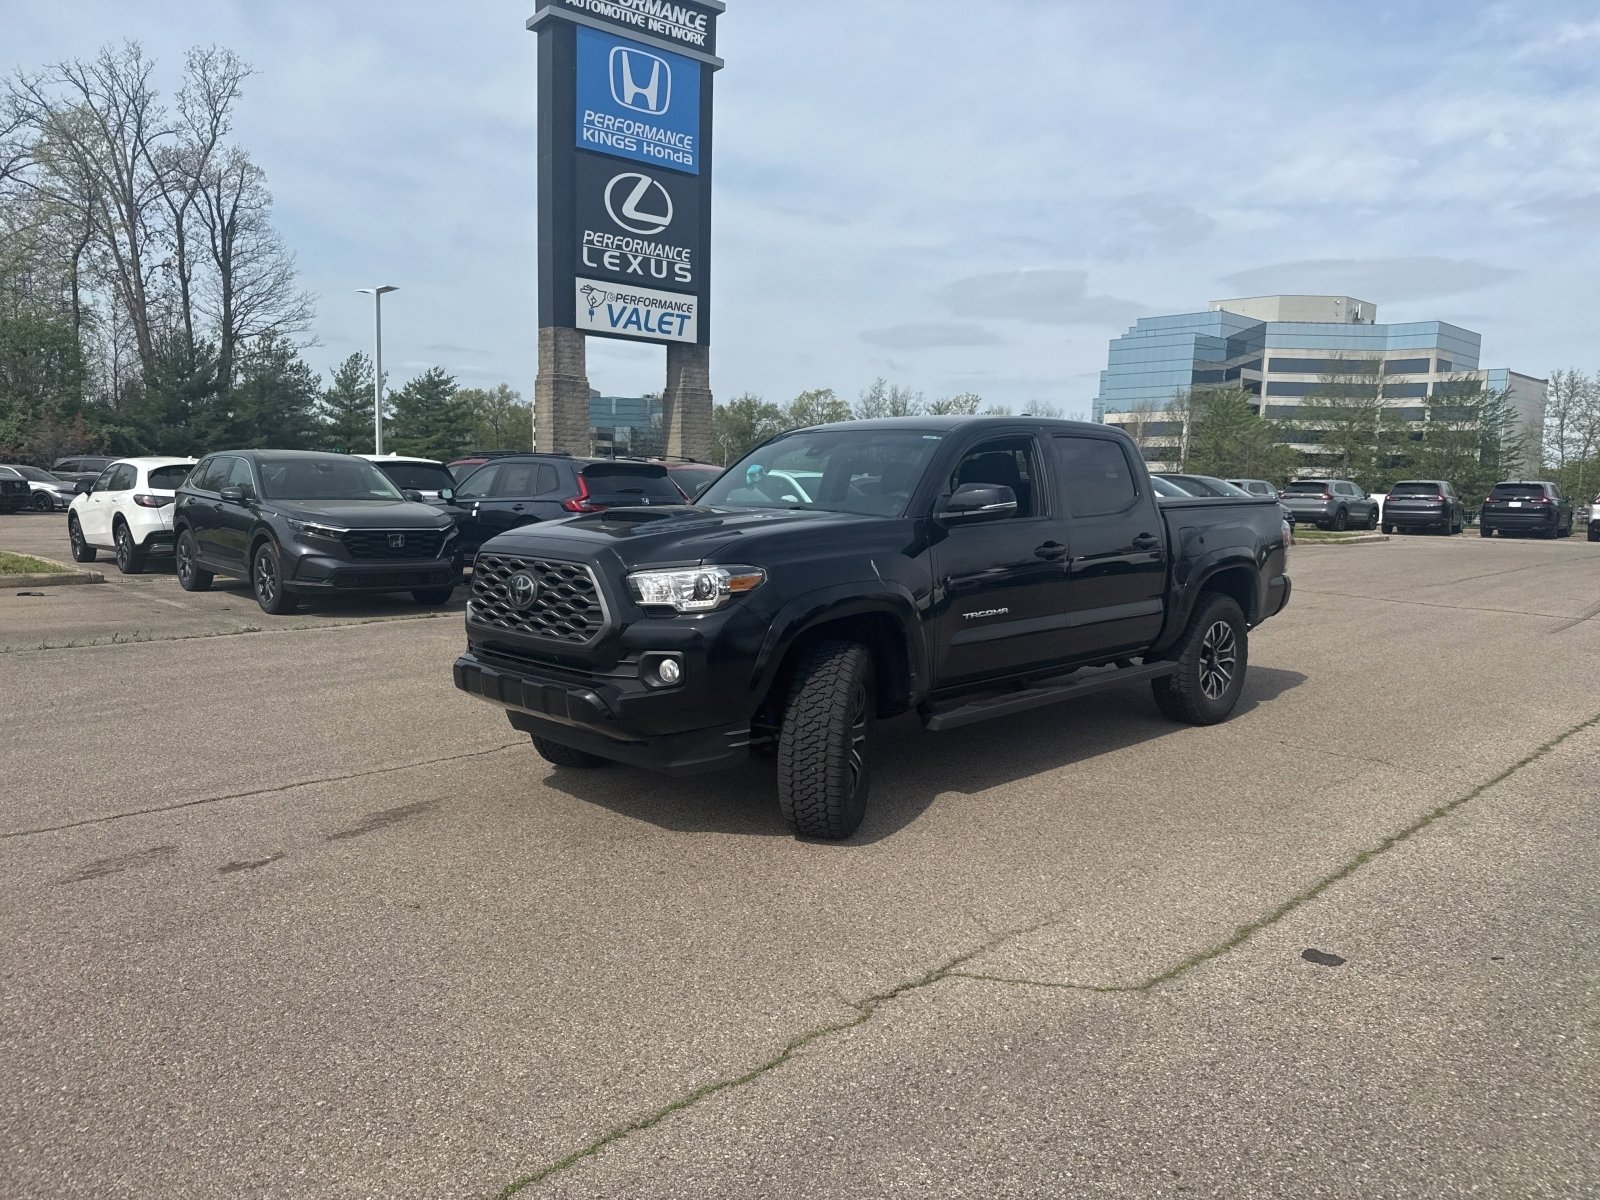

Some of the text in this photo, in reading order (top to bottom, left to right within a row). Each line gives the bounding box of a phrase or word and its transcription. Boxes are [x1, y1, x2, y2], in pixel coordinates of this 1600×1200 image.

[618, 0, 708, 32] RMANCE
[648, 18, 705, 47] NETWORK
[583, 109, 693, 149] PERFORMANCE
[583, 127, 693, 166] KINGS Honda
[582, 229, 691, 263] PERFORMANCE
[582, 246, 692, 283] LEXUS
[607, 303, 692, 337] VALET
[615, 293, 694, 314] PERFORMANCE
[961, 607, 1009, 620] TACOMA
